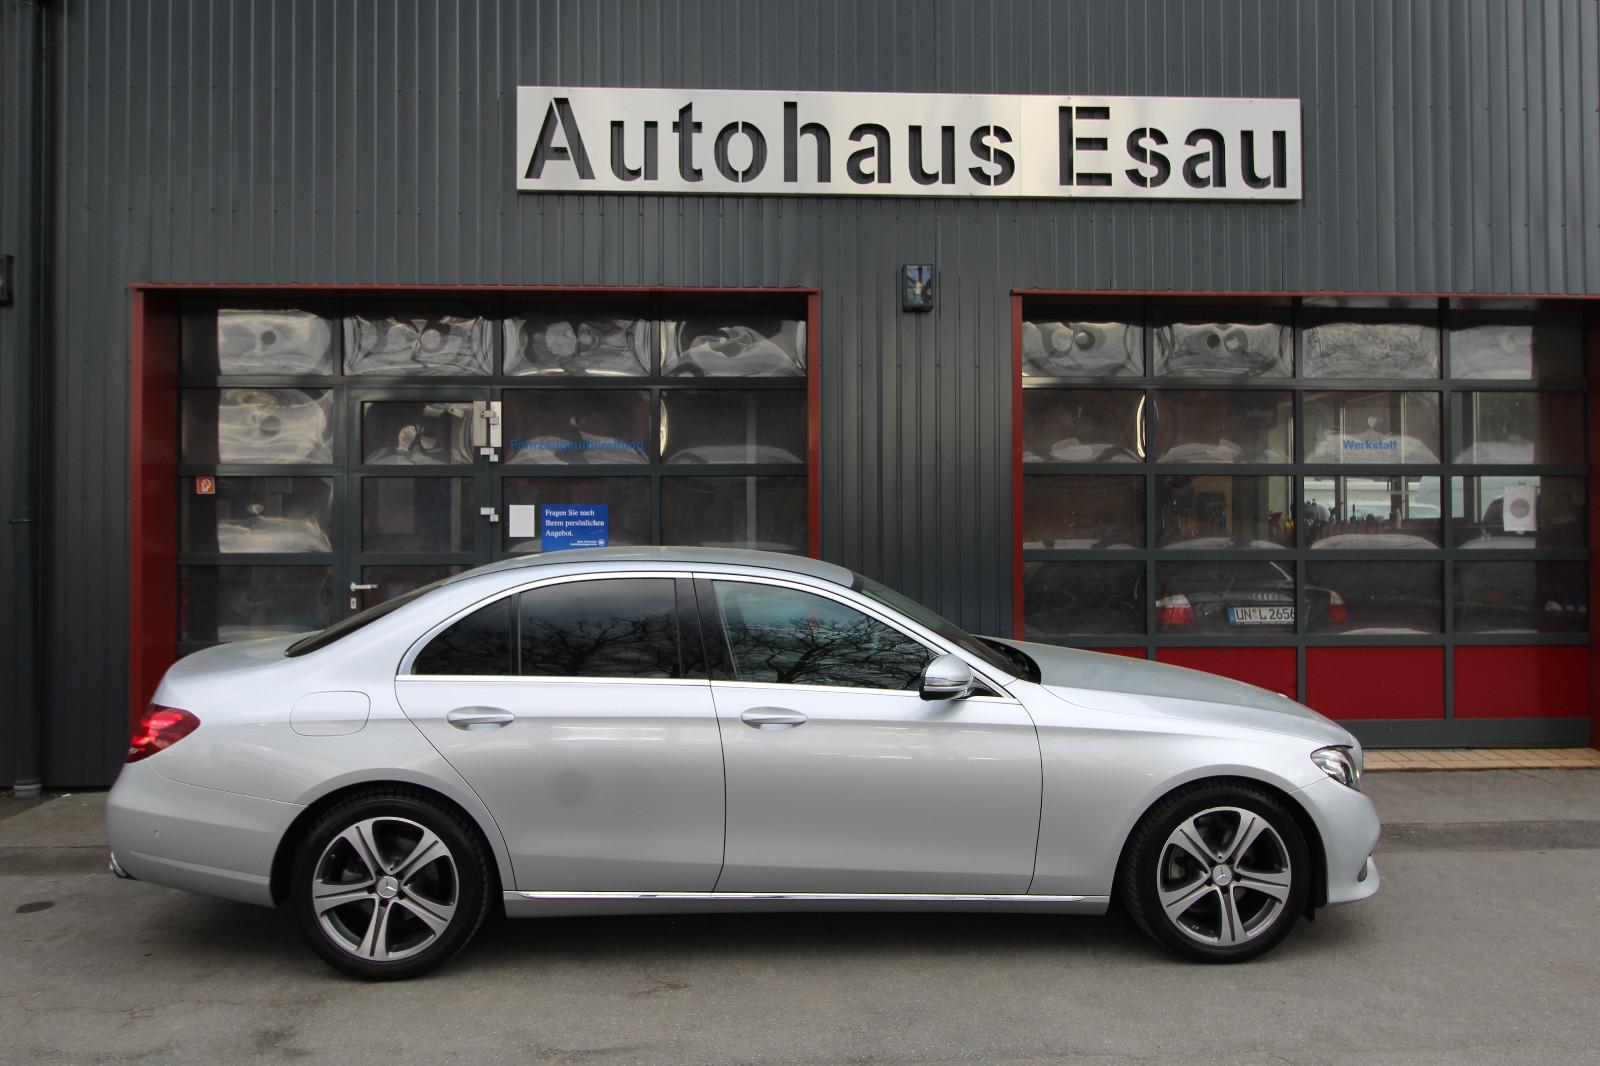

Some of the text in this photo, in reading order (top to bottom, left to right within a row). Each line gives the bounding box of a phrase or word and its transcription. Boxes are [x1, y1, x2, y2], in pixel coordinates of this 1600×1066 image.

[524, 97, 1287, 189] Autohaus Esau
[1344, 440, 1397, 449] Werkstatt
[545, 509, 566, 517] Fragen
[565, 519, 605, 528] persönlichen
[545, 530, 573, 538] Angebot.
[1236, 608, 1252, 620] UN
[1259, 608, 1266, 620] L
